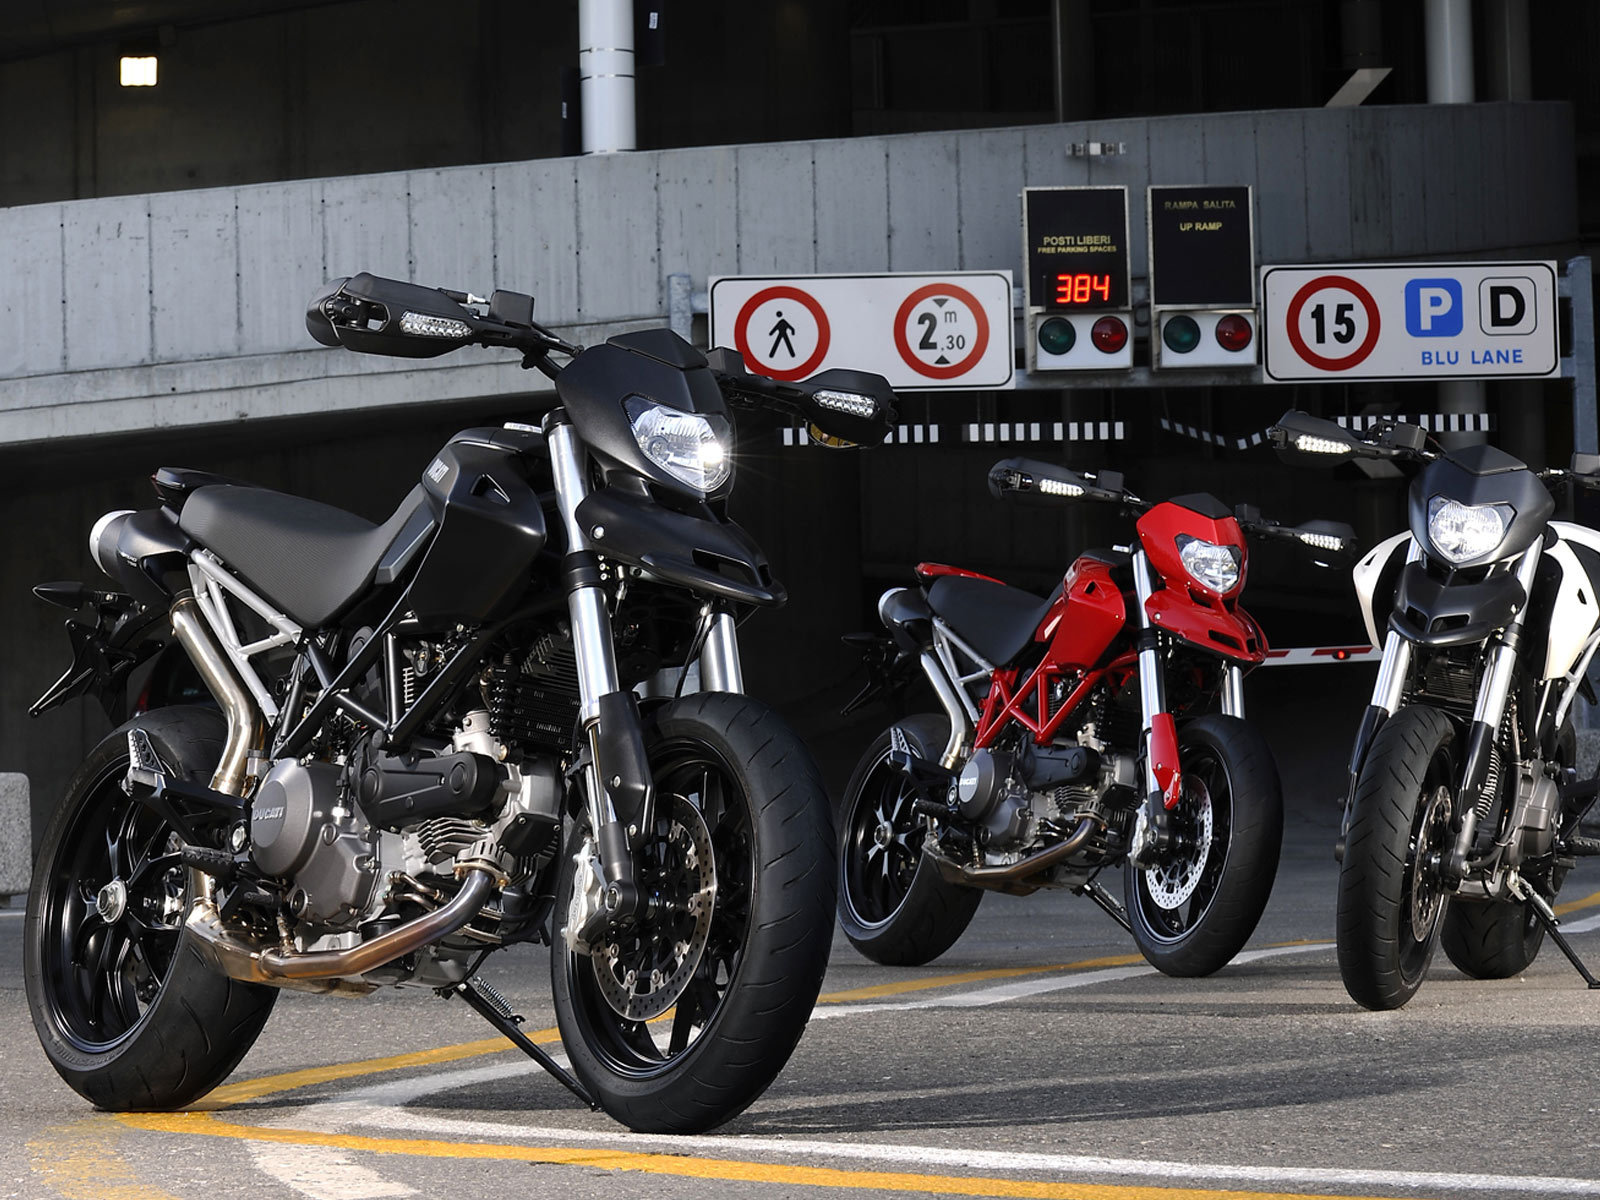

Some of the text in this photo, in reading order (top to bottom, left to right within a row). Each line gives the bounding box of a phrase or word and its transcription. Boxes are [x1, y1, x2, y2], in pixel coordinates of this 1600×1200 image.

[1164, 200, 1236, 209] RAMPA SALITA
[1180, 222, 1222, 231] UP RAMP
[1043, 235, 1111, 246] POSTI LIBERI
[1089, 245, 1117, 253] SPACES
[1056, 274, 1110, 303] 384
[1420, 285, 1526, 330] P D
[944, 311, 957, 323] m
[1311, 303, 1356, 344] 15
[1421, 349, 1523, 365] BLU LANE
[253, 807, 284, 820] DUCATI
